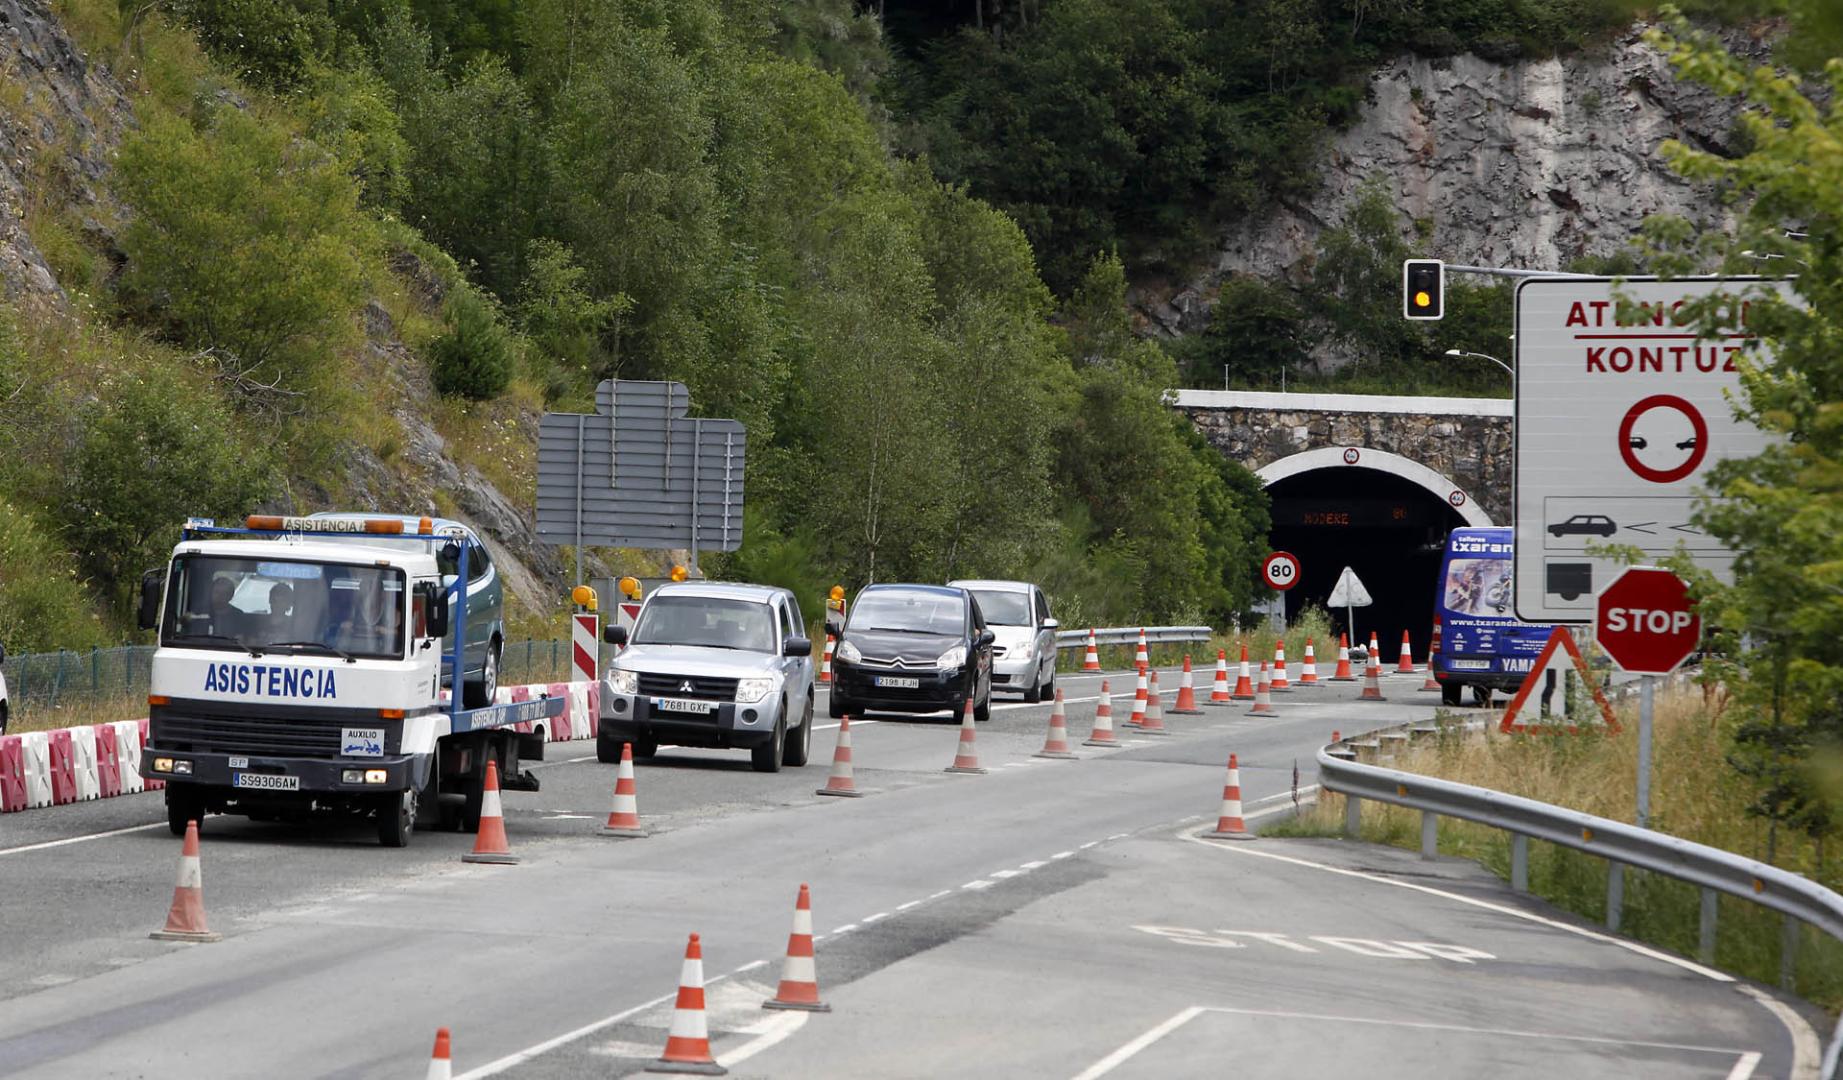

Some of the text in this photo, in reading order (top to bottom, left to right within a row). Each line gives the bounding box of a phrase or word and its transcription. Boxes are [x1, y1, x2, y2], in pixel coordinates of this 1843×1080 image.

[1586, 346, 1742, 373] KONTUZ
[285, 519, 360, 531] ASISTENCIA
[1452, 541, 1513, 553] txaran
[1271, 565, 1291, 577] 80
[1606, 607, 1692, 635] STOP
[204, 663, 336, 698] ASISTENCIA
[664, 700, 708, 713] 7681 GXF
[348, 730, 377, 739] AUXILIO
[240, 774, 297, 790] SS9306AM
[1130, 925, 1497, 964] STOP
